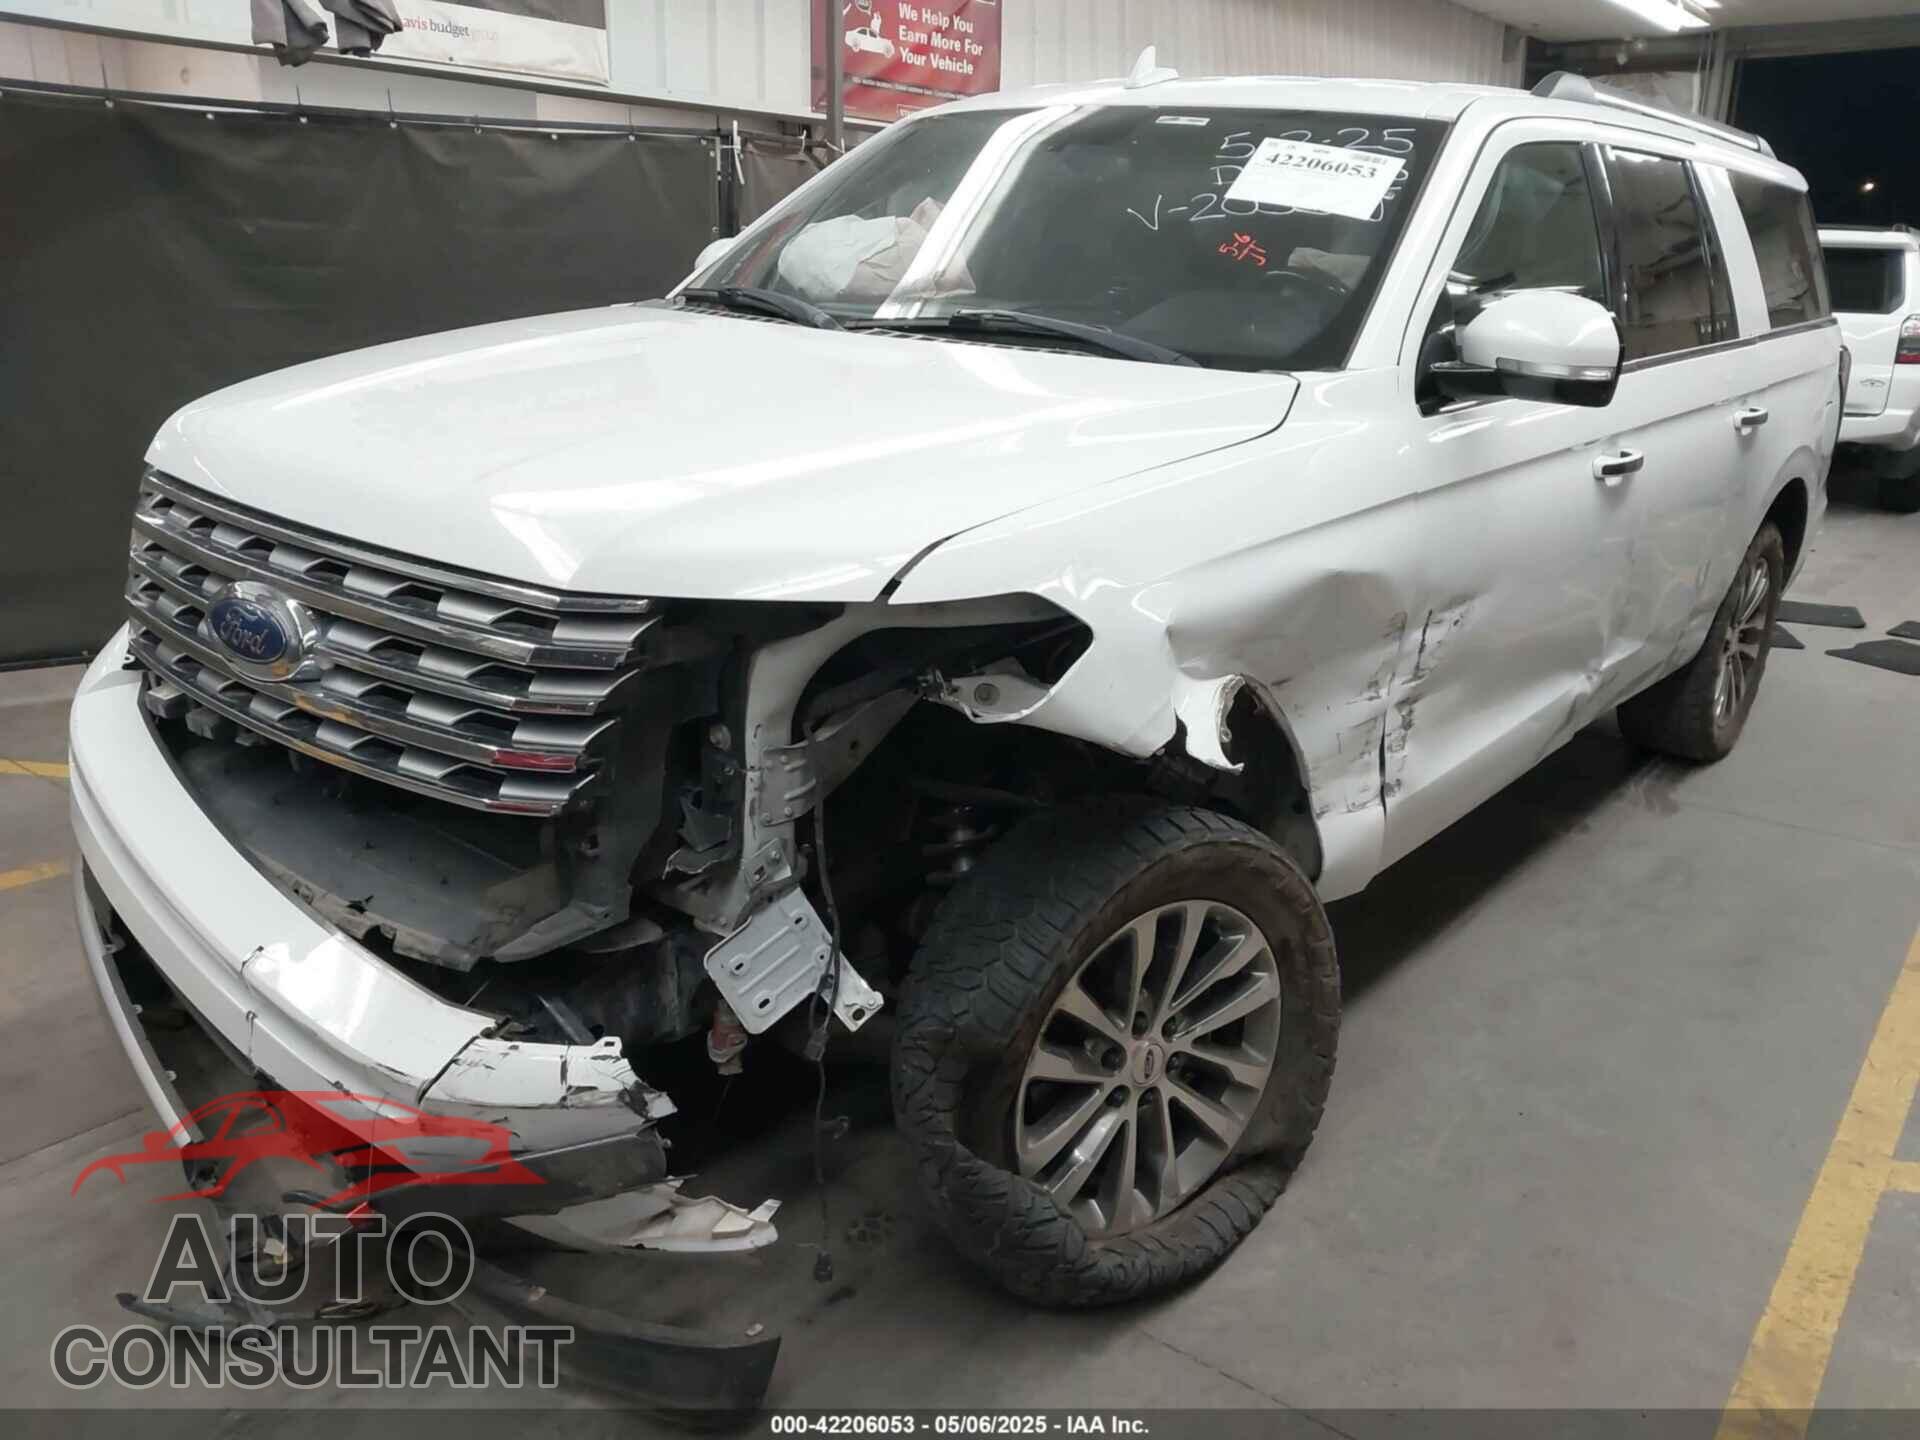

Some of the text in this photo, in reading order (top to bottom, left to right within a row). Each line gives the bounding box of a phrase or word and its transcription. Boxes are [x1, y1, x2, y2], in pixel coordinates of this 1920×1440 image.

[402, 17, 428, 31] avis
[430, 19, 470, 38] budget
[899, 3, 974, 33] We Help You
[899, 25, 983, 56] Earn More For
[900, 47, 974, 75] Your Vehicle
[1265, 152, 1377, 179] 42206053
[220, 606, 268, 655] Ford
